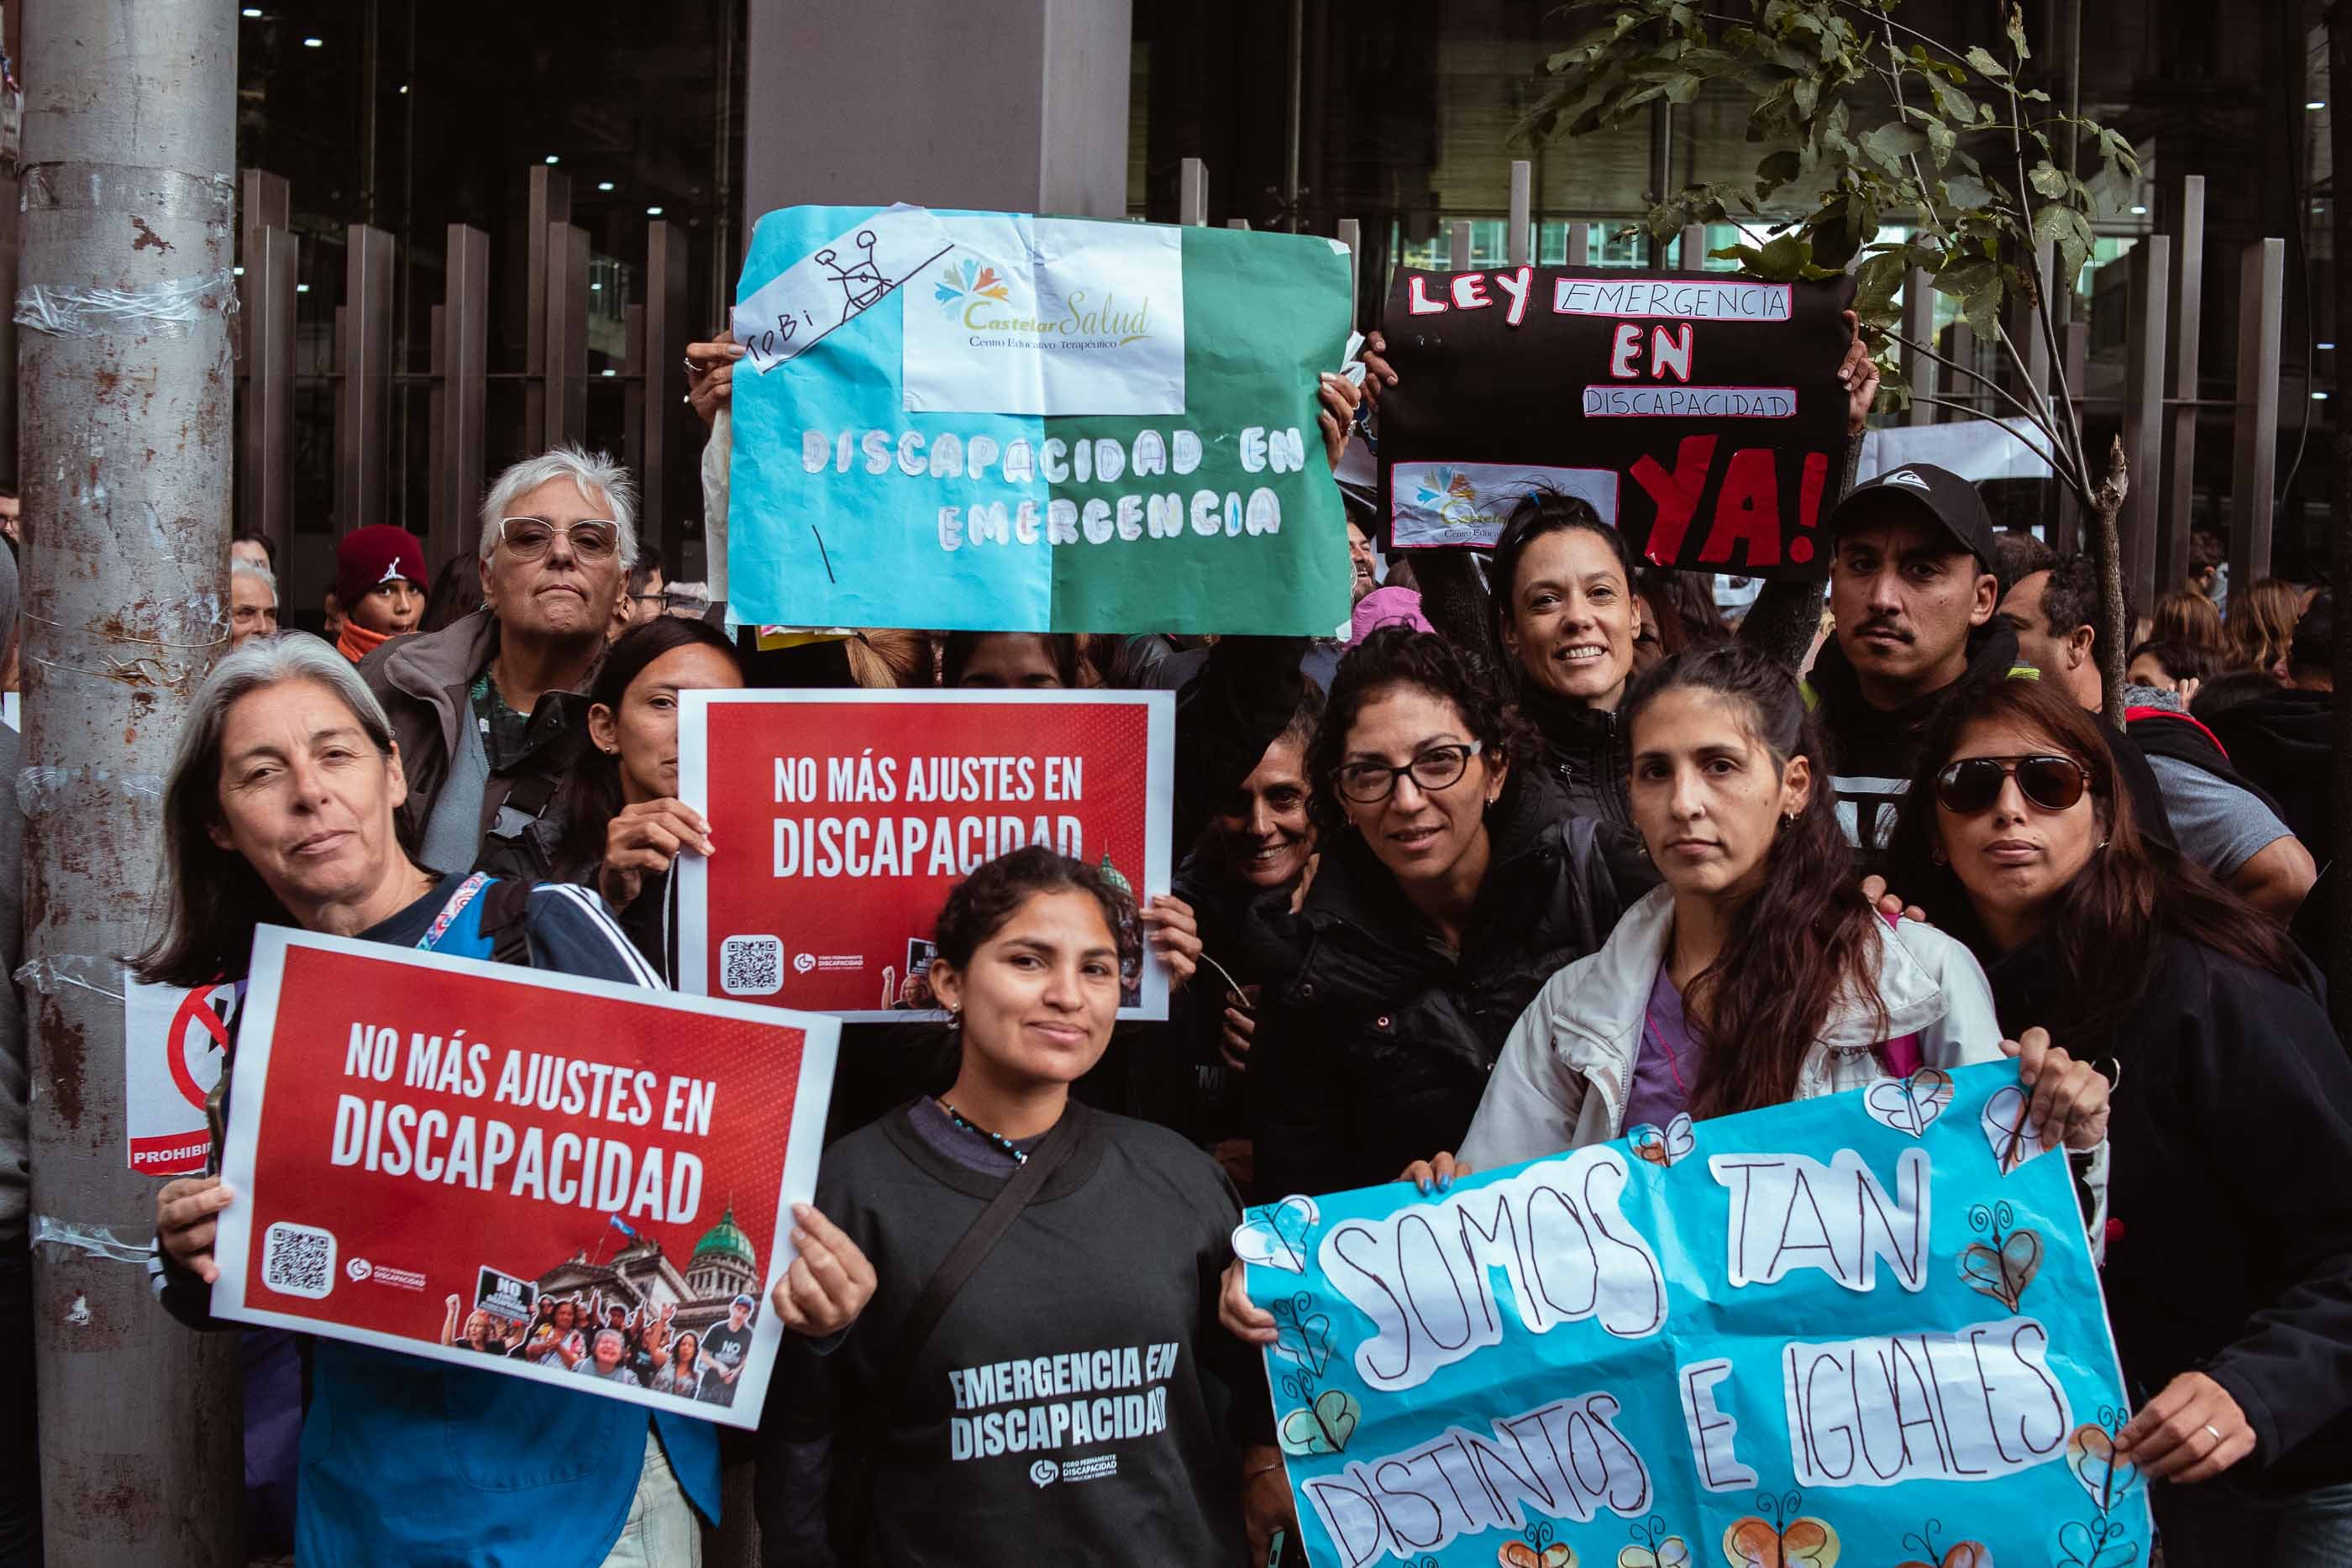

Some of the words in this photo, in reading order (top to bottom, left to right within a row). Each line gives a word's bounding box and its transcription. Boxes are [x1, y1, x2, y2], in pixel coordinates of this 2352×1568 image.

[964, 302, 1057, 332] Castelar
[1059, 291, 1150, 335] Salud
[1408, 265, 1533, 326] LEY
[1562, 284, 1787, 317] EMERGENCIA
[969, 335, 1005, 348] Centro
[1008, 338, 1056, 349] Educativo
[1610, 323, 1693, 382] EN
[1585, 390, 1789, 417] DISCAPACIDAD
[802, 427, 1203, 484] DISCAPACIDAD
[1239, 427, 1305, 474] EN
[937, 487, 1282, 552] EMERGENCIA
[1629, 434, 1829, 568] YA!
[774, 757, 817, 803] NO
[827, 747, 897, 803] MÁS
[906, 757, 1035, 802] AJUSTES
[1044, 756, 1083, 801] EN
[773, 815, 1083, 878] DISCAPACIDAD
[344, 1022, 399, 1083] NO
[404, 1029, 491, 1099] MÁS
[494, 1049, 656, 1126] AJUSTES
[663, 1075, 717, 1136] EN
[134, 1141, 213, 1164] PROHIBI
[330, 1093, 704, 1225] DISCAPACIDAD
[1334, 1162, 1661, 1381] SOMOS
[1719, 1155, 1922, 1284] TAN
[948, 1346, 1142, 1410] EMERGENCIA
[1146, 1342, 1179, 1382] EN
[951, 1386, 1168, 1461] DISCAPACIDAD
[1310, 1396, 1646, 1568] DISTINTOS
[1690, 1364, 1752, 1487] E
[1790, 1322, 2066, 1481] IGUALES
[1063, 1461, 1116, 1476] DISCAPACIDAD
